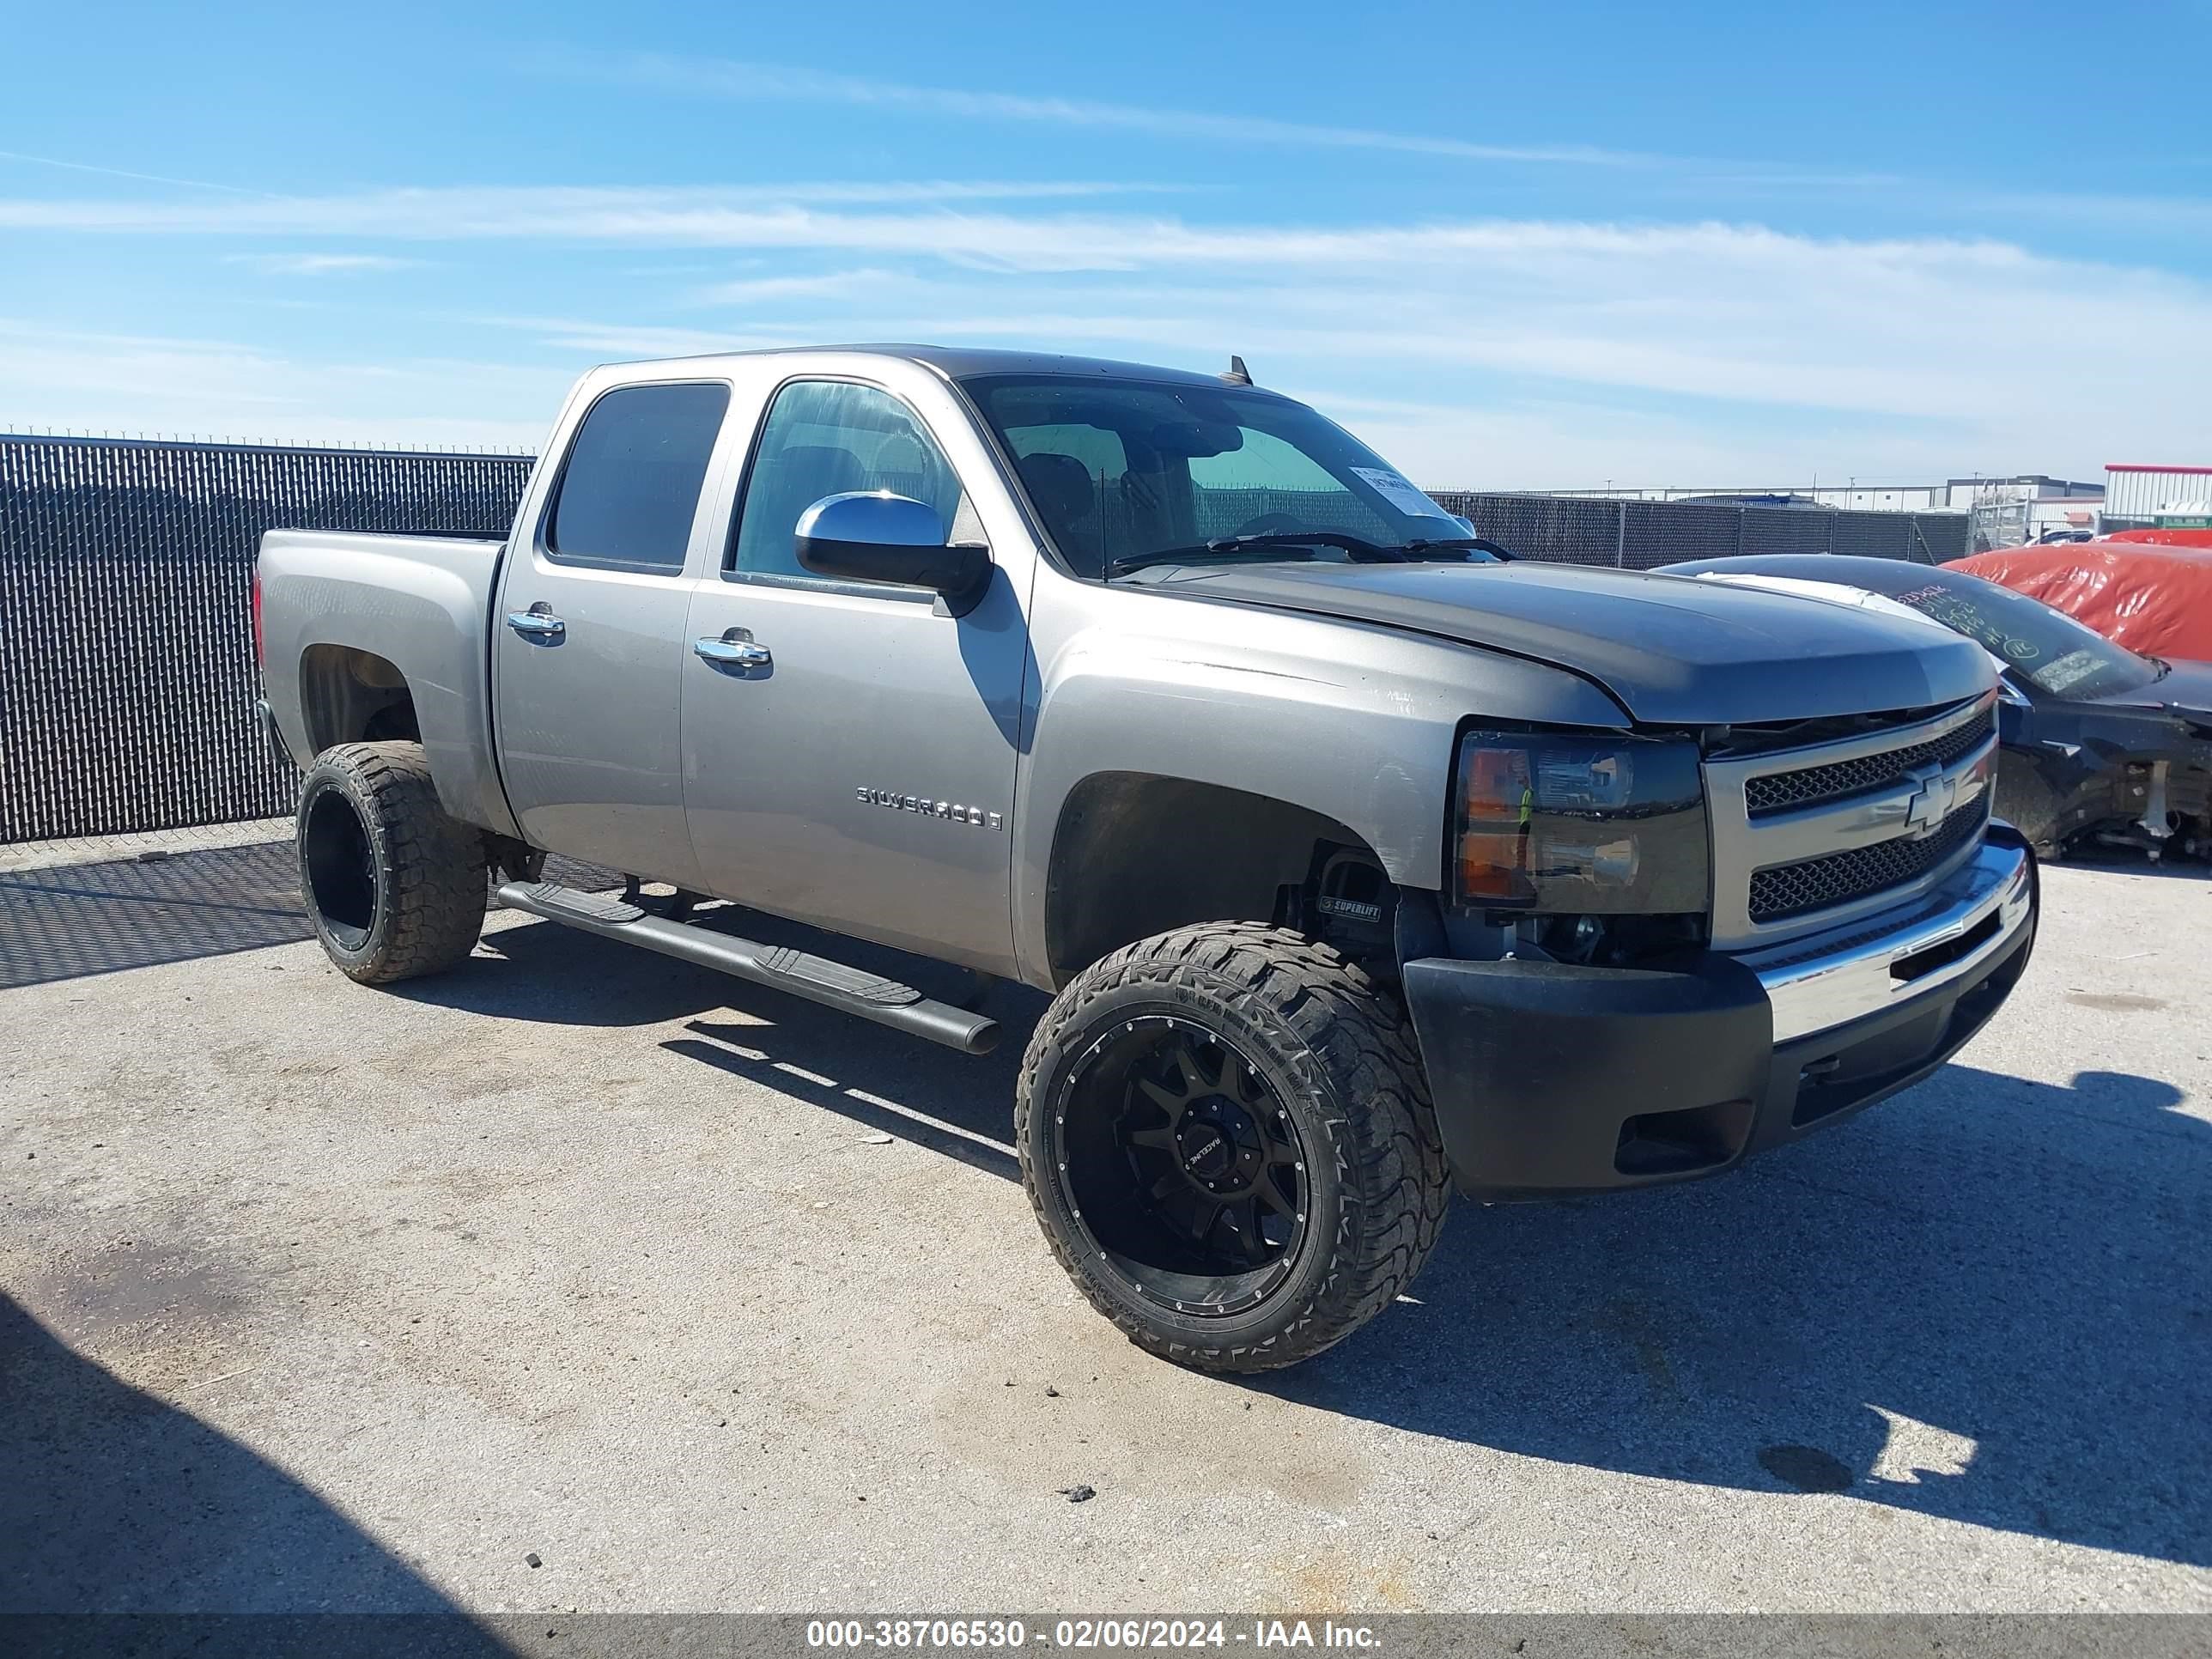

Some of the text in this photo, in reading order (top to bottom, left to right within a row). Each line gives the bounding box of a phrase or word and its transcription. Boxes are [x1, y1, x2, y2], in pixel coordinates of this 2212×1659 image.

[857, 787, 986, 826] SILVERADO
[1334, 900, 1378, 916] SUPERLIFT
[1189, 1137, 1221, 1165] RACELINE
